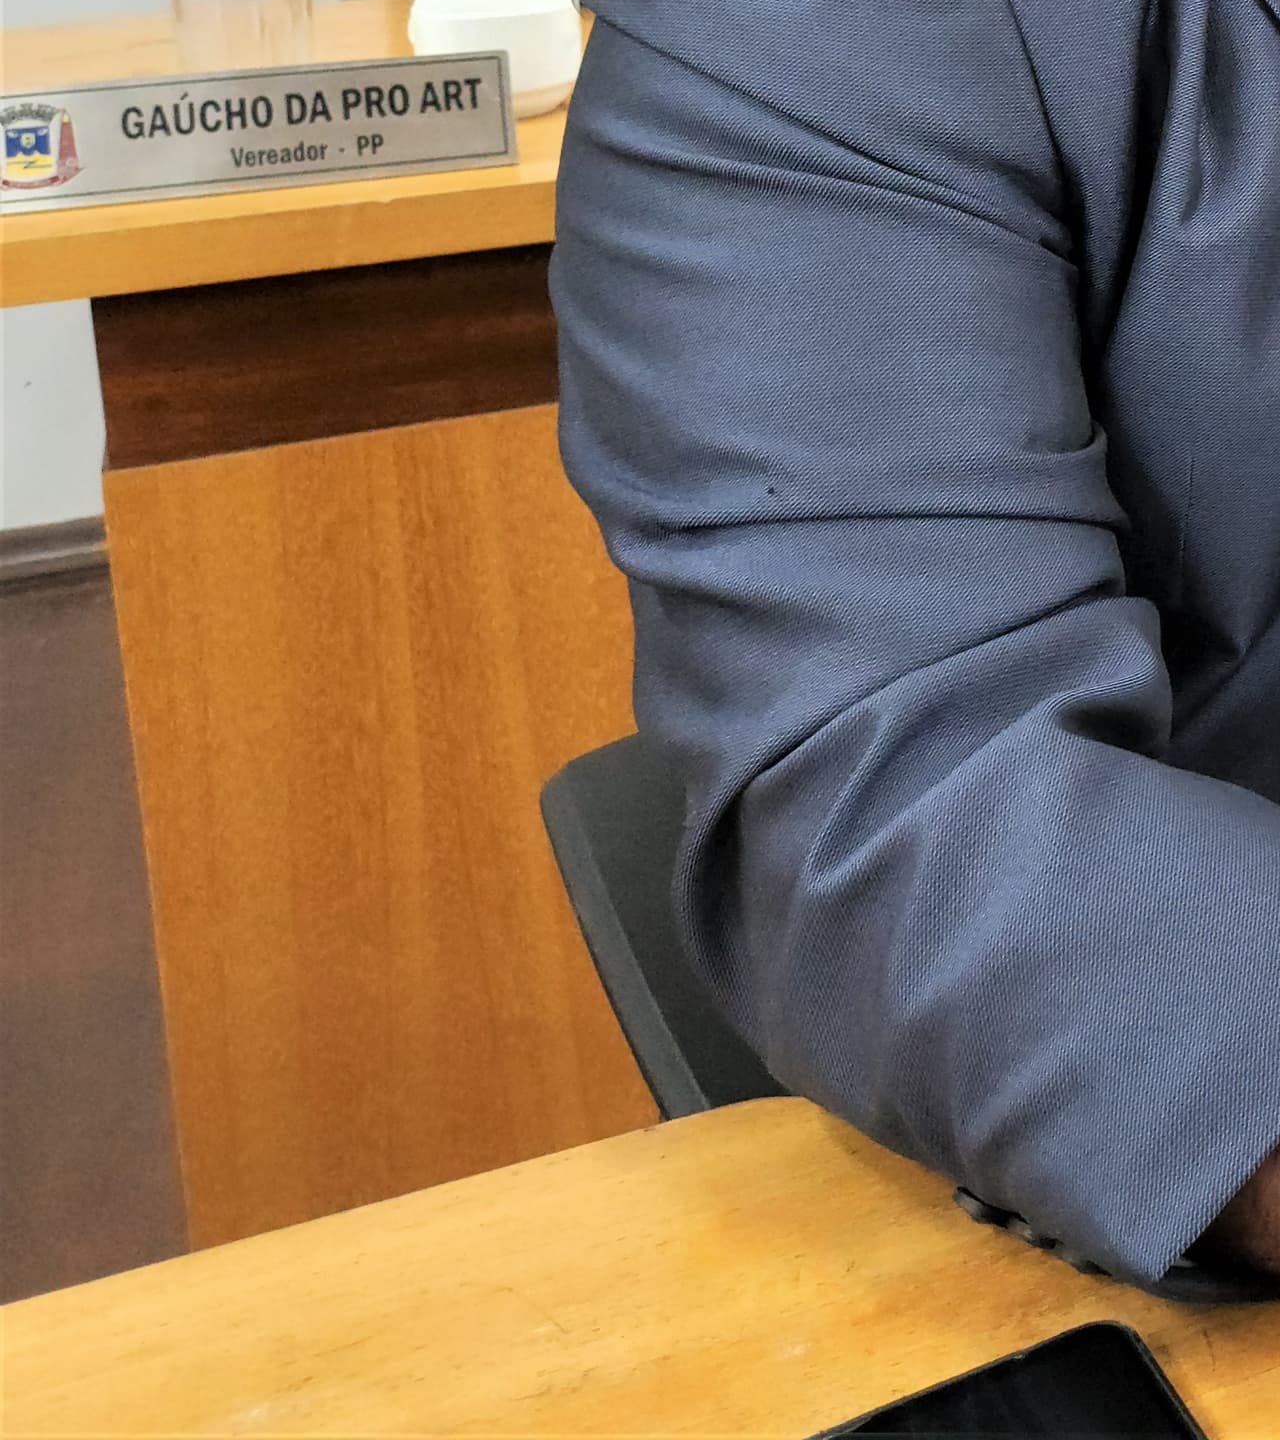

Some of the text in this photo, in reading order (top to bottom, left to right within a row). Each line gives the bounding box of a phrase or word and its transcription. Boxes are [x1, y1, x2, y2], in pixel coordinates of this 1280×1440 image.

[121, 77, 482, 140] GAÚCHO DA PRO ART
[231, 142, 327, 169] Vereador
[357, 134, 384, 156] PP
